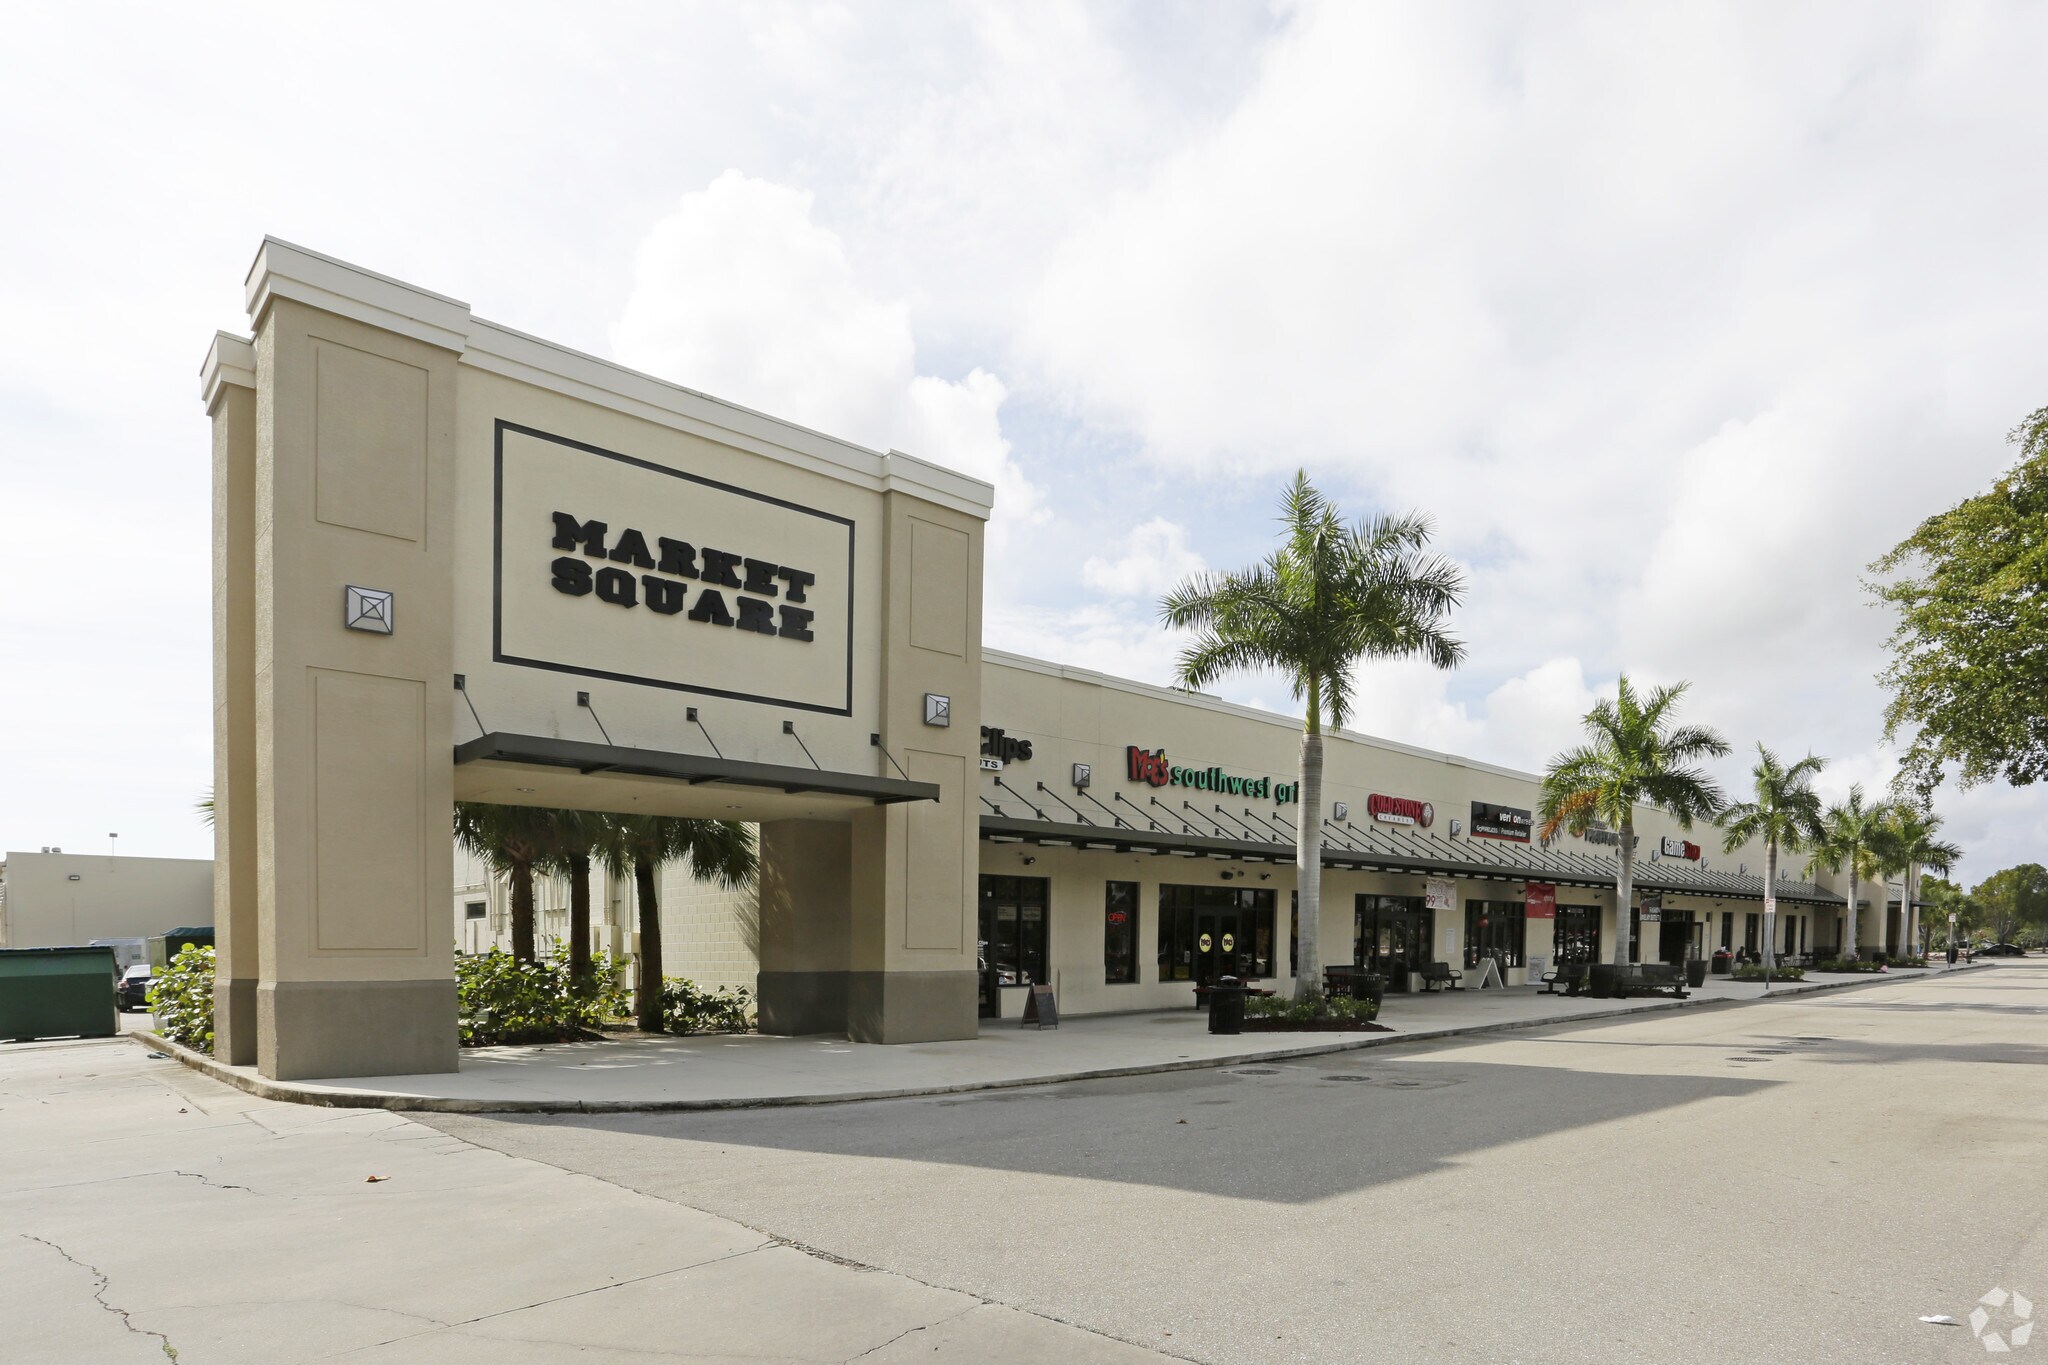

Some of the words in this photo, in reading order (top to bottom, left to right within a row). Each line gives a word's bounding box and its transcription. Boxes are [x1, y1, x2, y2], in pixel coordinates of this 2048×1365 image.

[552, 511, 815, 603] MARKET
[551, 556, 814, 642] SQUARE
[1170, 766, 1271, 798] southwest
[1367, 794, 1393, 816] COLD
[1392, 798, 1422, 822] STONE
[1108, 913, 1126, 922] OPEN
